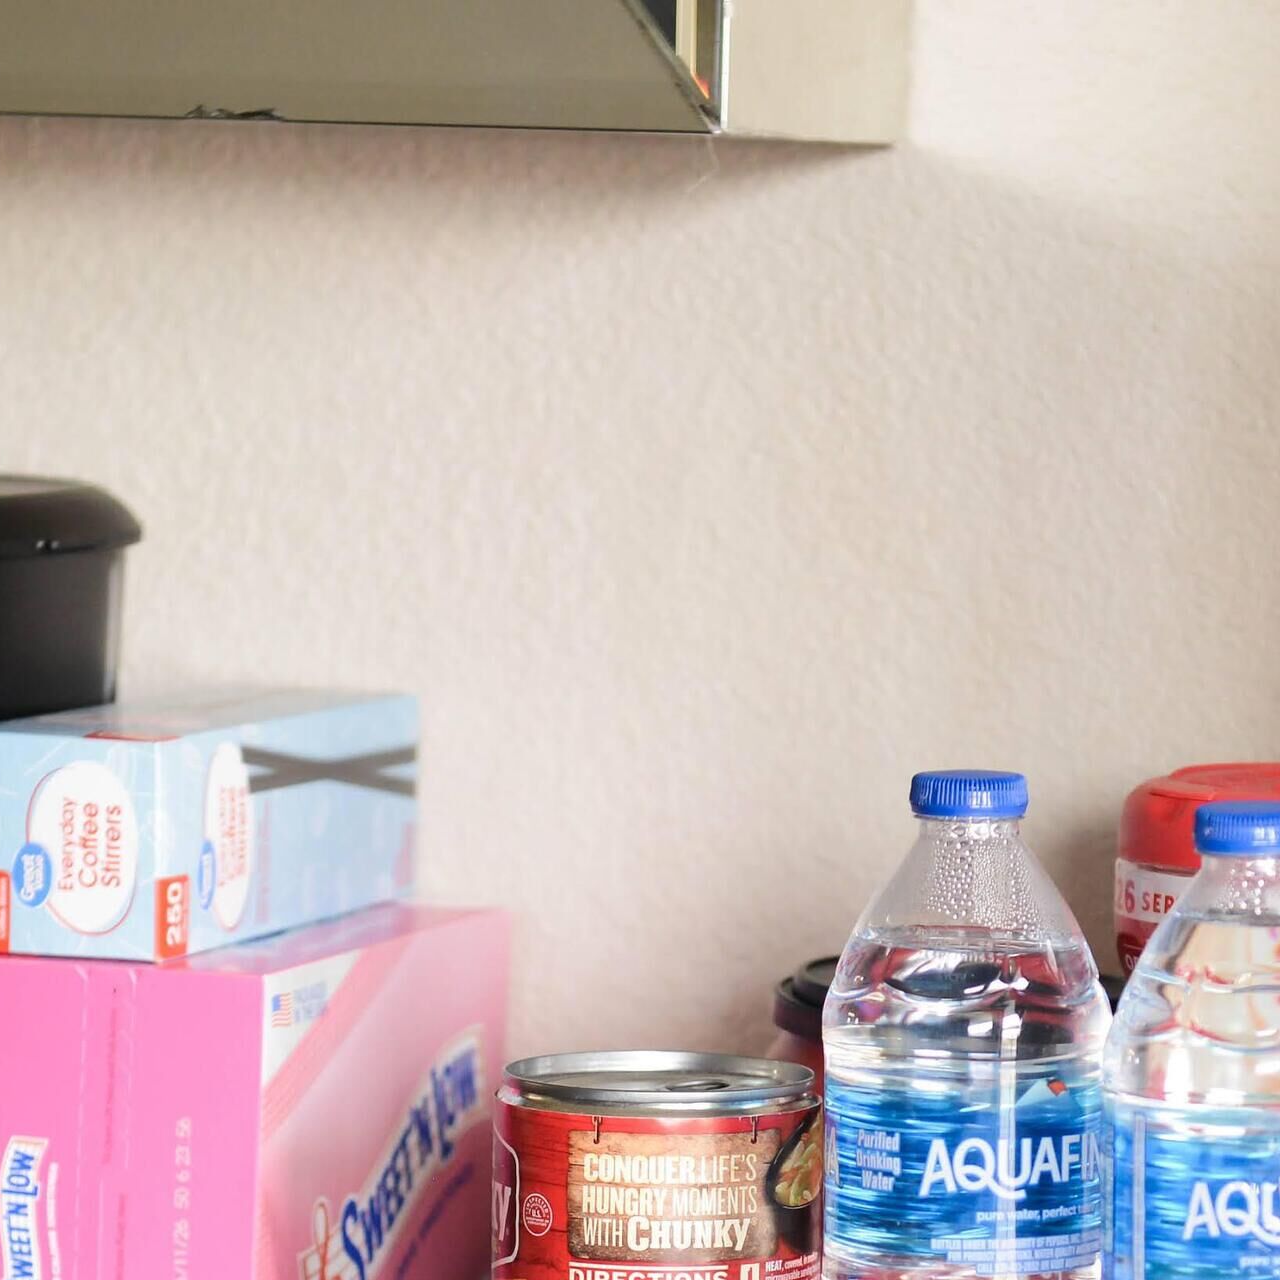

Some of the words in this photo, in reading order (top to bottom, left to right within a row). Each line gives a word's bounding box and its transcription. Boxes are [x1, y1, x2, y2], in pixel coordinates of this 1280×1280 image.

[58, 797, 80, 891] Everyday
[78, 802, 98, 888] Coffee
[101, 805, 122, 888] Stirrers
[166, 881, 183, 946] 250
[858, 1130, 900, 1151] Purified
[1, 1151, 38, 1198] LOW
[583, 1153, 696, 1184] CONQUER
[700, 1153, 757, 1184] LIFE'S
[856, 1150, 901, 1176] Drinking
[861, 1170, 895, 1192] Water
[582, 1184, 667, 1216] HUNGRY
[673, 1185, 757, 1216] MOMENTS
[976, 1211, 1005, 1223] pure
[1007, 1209, 1040, 1220] water,
[1042, 1205, 1077, 1220] perfect
[583, 1217, 623, 1247] WITH
